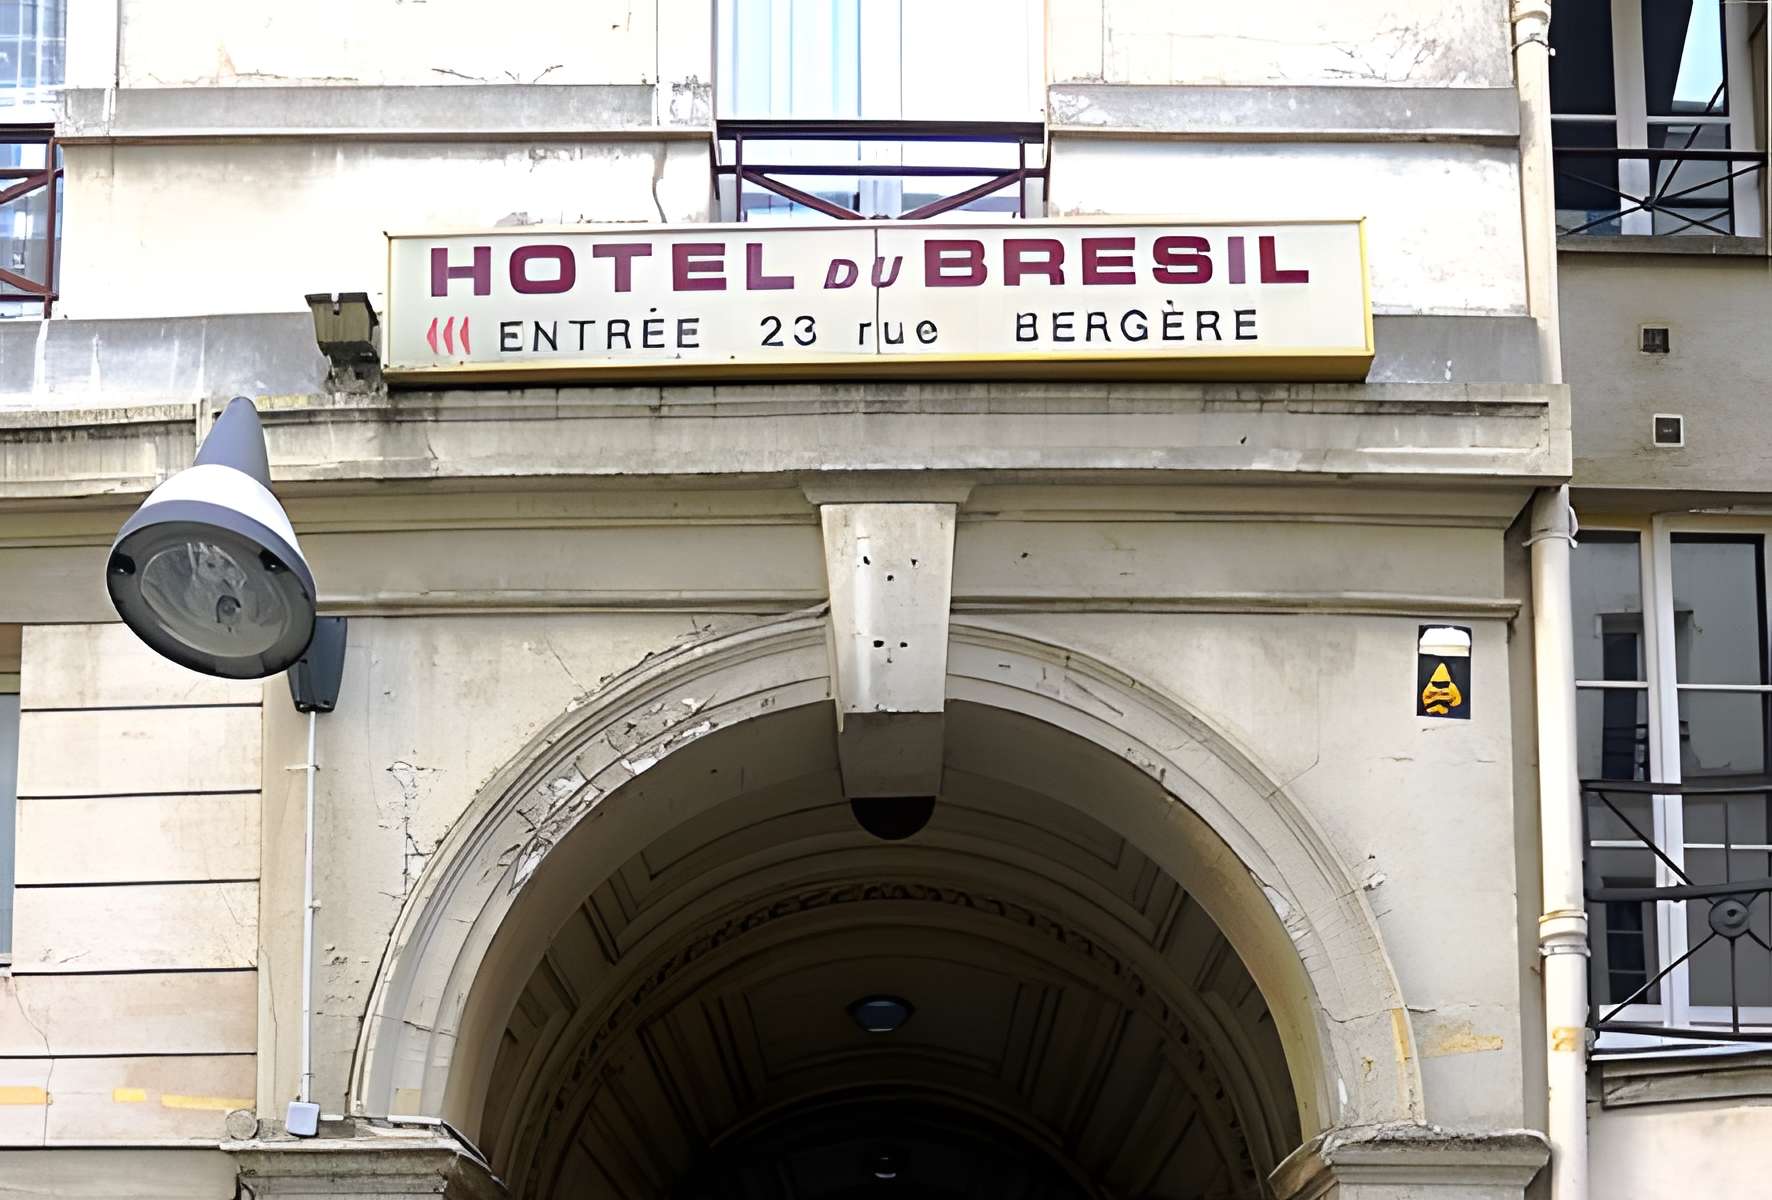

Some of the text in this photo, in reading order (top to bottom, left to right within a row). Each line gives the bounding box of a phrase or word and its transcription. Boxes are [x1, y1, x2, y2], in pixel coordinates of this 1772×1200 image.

[430, 235, 1310, 298] HOTEL DU BRESIL
[499, 299, 1260, 353] ENTRÉE 23 rue BERGÈRE
